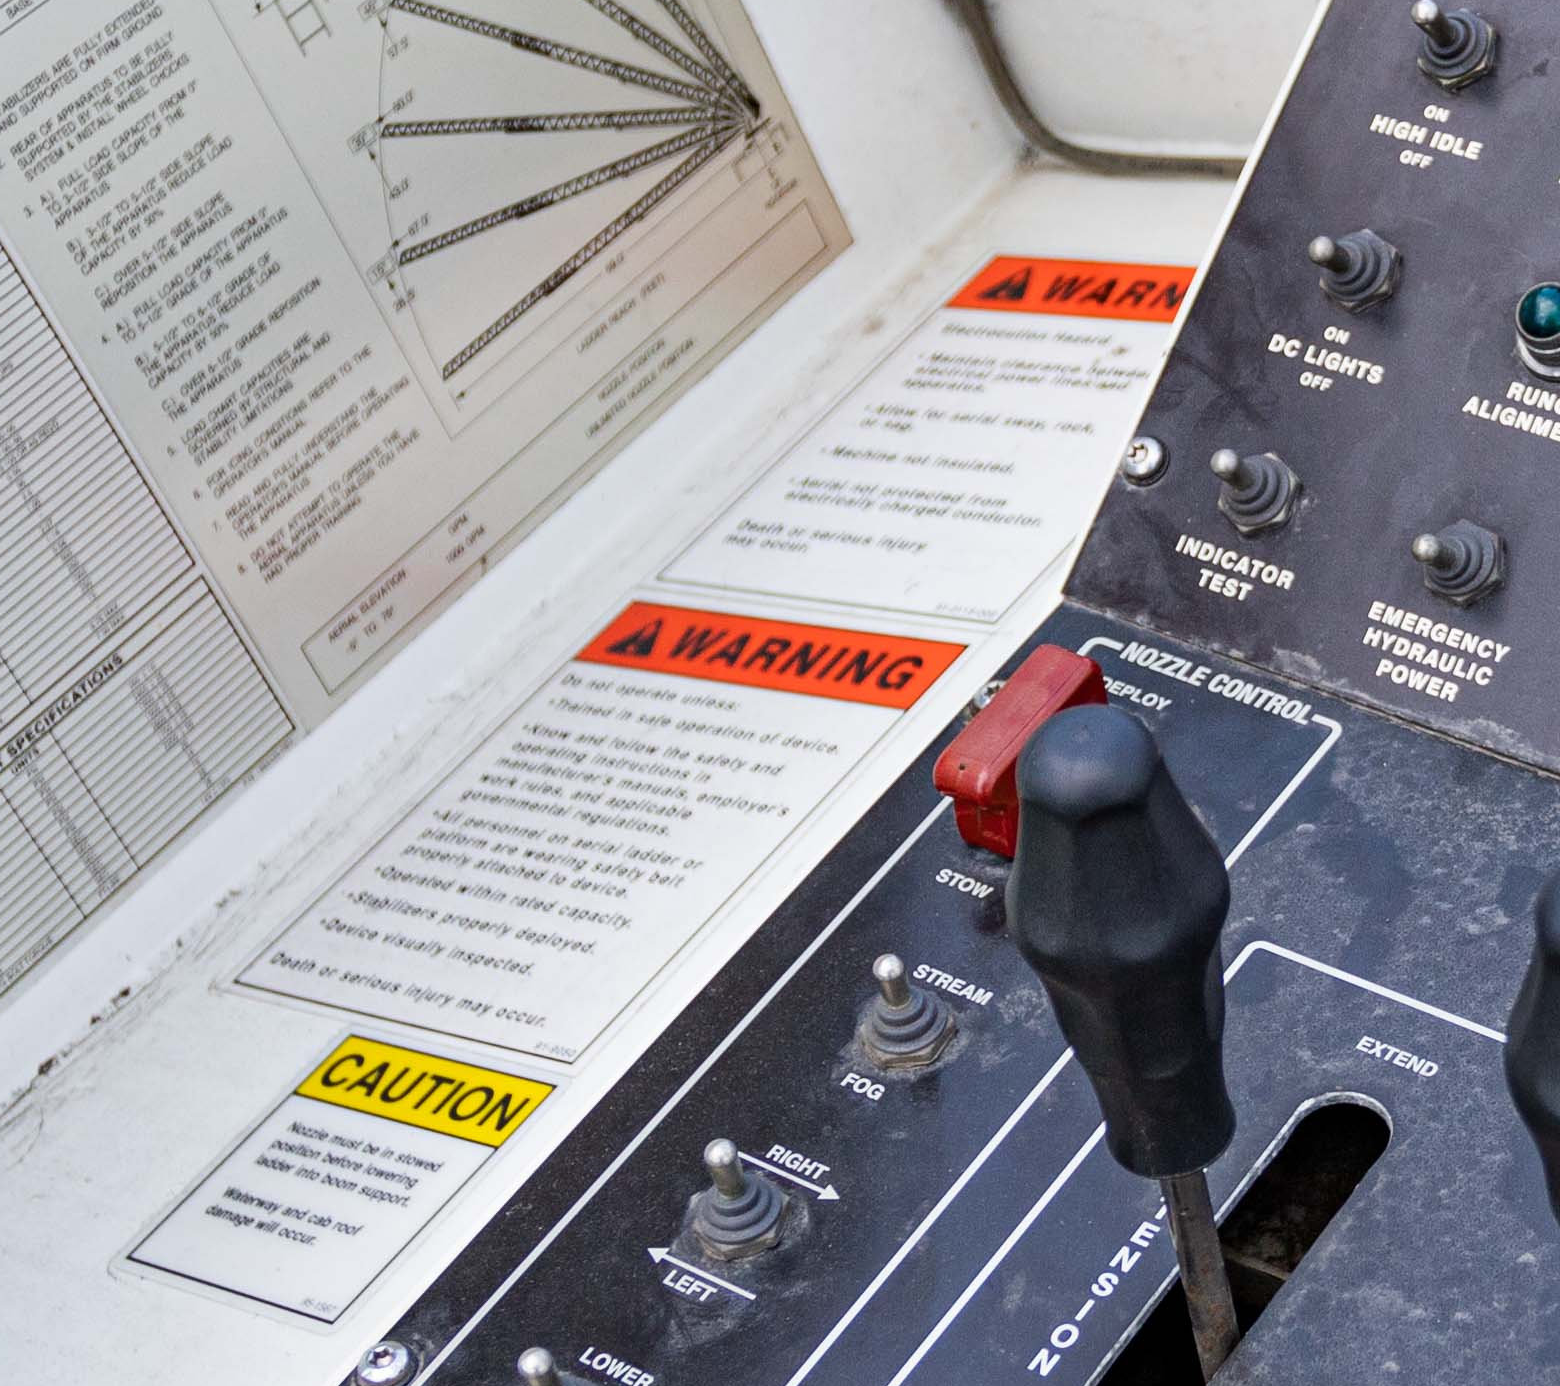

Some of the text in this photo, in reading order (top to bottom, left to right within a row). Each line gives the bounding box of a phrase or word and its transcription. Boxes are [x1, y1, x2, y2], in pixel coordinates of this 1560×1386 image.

[1422, 104, 1450, 123] ON
[1369, 113, 1482, 160] HIGH IDLE
[1398, 148, 1433, 168] OFF
[1043, 275, 1187, 309] WARN
[1323, 325, 1350, 344] ON
[1267, 333, 1383, 384] DC LIGHTS
[1299, 370, 1333, 391] OFF
[1175, 534, 1294, 589] INDICATOR
[1198, 567, 1253, 600] TEST
[1368, 601, 1509, 662] EMERGENCY
[670, 626, 922, 689] WARNING
[1362, 627, 1492, 685] HYDRAULIC
[1102, 675, 1172, 710] DEPLOY
[1119, 641, 1311, 725] NOZZLE CONTROL
[1375, 658, 1458, 701] POWER
[6, 648, 123, 762] SPECIFICATIONS
[934, 867, 993, 898] STOW
[912, 963, 993, 1005] STREAM
[1355, 1035, 1438, 1077] EXTEND
[321, 1053, 528, 1130] CAUTION
[839, 1071, 885, 1100] FOG
[269, 1139, 418, 1190] position before lowering
[290, 1121, 443, 1172] Nozzle must be in stowed
[765, 1143, 830, 1179] RIGHT
[255, 1154, 294, 1172] ladder
[294, 1166, 321, 1181] into
[319, 1172, 358, 1191] boom
[204, 1204, 255, 1227] damage
[254, 1219, 280, 1233] will
[280, 1206, 308, 1220] and
[306, 1213, 332, 1228] cab
[331, 1220, 364, 1236] roof
[662, 1269, 717, 1301] LEFT
